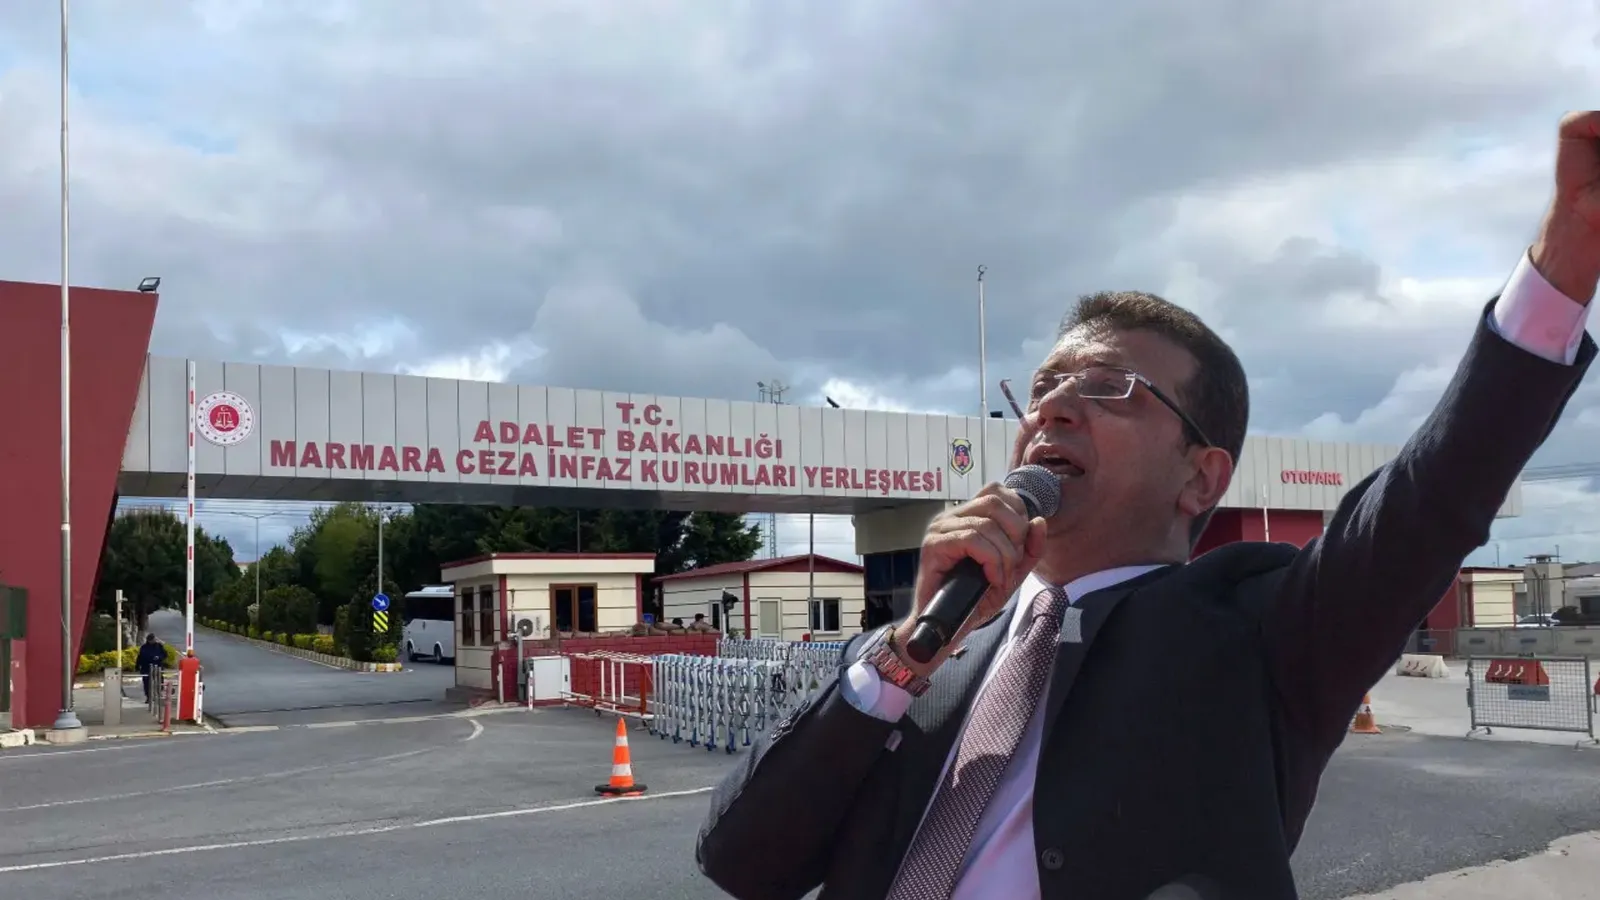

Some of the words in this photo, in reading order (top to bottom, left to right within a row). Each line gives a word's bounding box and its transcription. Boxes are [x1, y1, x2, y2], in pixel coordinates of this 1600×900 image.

[615, 402, 674, 425] T.C.
[474, 421, 605, 450] ADALET
[617, 430, 783, 458] BAKANLIĞI
[270, 440, 445, 473] MARMARA
[456, 449, 538, 476] CEZA
[547, 445, 632, 480] İNFAZ
[641, 460, 796, 487] KURUMLARI
[805, 465, 943, 494] YERLEŞKESİ
[1281, 470, 1343, 485] OTOPARK
